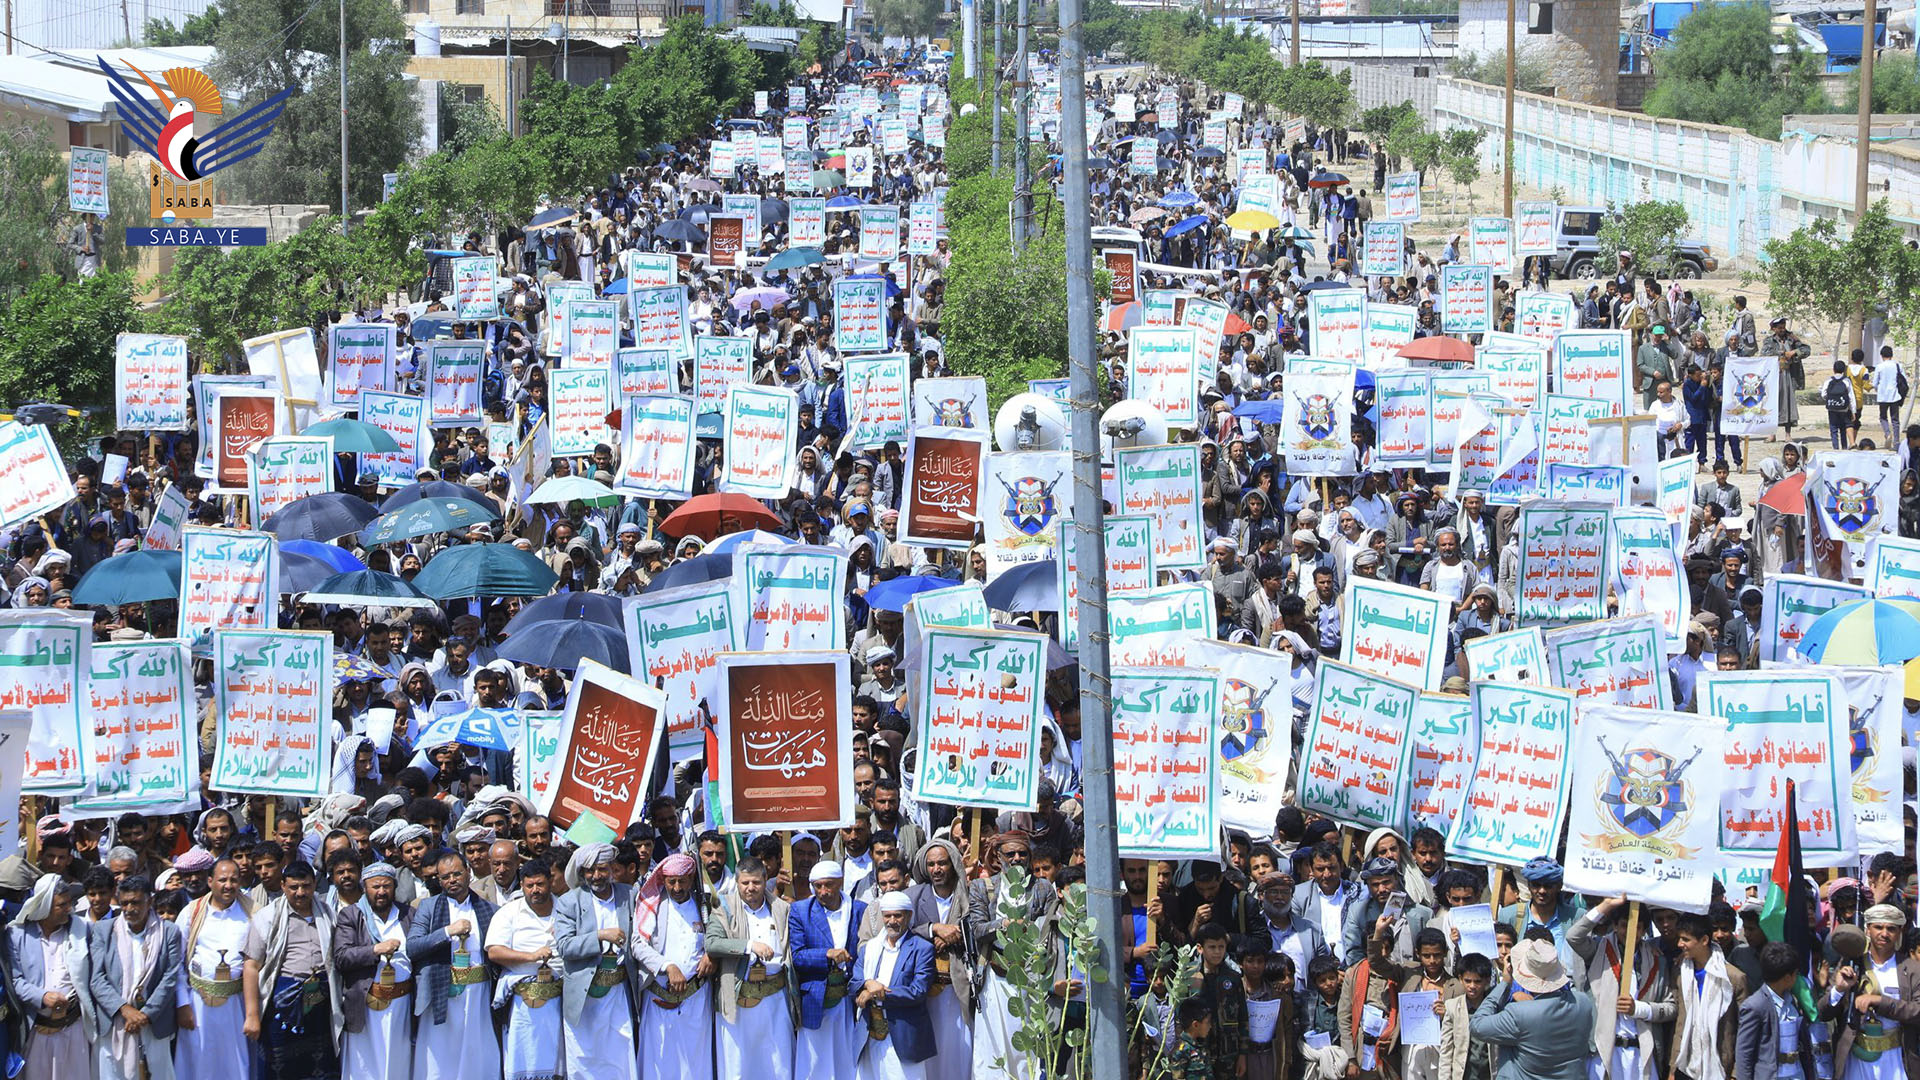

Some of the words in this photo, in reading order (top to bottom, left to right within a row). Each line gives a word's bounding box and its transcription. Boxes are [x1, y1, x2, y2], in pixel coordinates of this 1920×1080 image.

[126, 340, 162, 359] أكبر
[1137, 340, 1191, 356] قاطعوا
[1563, 342, 1620, 360] قاطعوا
[157, 364, 181, 374] الموت
[1563, 366, 1593, 383] الأمريكية
[1593, 368, 1620, 382] البضائع
[157, 379, 181, 391] الموت
[557, 373, 585, 392] أكبر
[634, 403, 688, 424] قاطعوا
[735, 400, 786, 419] قاطعوا
[1549, 401, 1584, 419] أكبر
[1584, 402, 1609, 418] الله
[760, 425, 785, 441] البضائع
[260, 446, 297, 470] أكبر
[298, 449, 324, 465] الله
[1125, 461, 1192, 485] قاطعوا
[1555, 467, 1593, 492] أكبر
[1595, 471, 1620, 490] الله
[1125, 491, 1161, 511] الأمريكية
[1162, 490, 1192, 509] البضائع
[1529, 515, 1576, 541] أكبر
[1575, 519, 1603, 537] الله
[1617, 529, 1671, 554] قاطعوا
[1527, 544, 1566, 560] لأمريكا
[1569, 545, 1600, 559] الموت
[751, 565, 829, 596] قاطعوا
[1525, 565, 1565, 581] لإسرائيل
[1567, 566, 1600, 579] الموت
[1523, 586, 1552, 601] اليهود
[1554, 589, 1570, 601] على
[1573, 586, 1597, 598] اللعنة
[753, 602, 791, 625] الأمريكية
[792, 606, 829, 626] البضائع
[1358, 599, 1431, 636] قاطعوا
[1521, 604, 1560, 620] للإسلام
[1566, 604, 1598, 621] النصر
[644, 605, 727, 649] قاطعوا
[782, 631, 790, 649] و
[1354, 637, 1392, 662] الأمريكية
[225, 642, 283, 672] أكبر
[284, 648, 319, 670] الله
[935, 641, 996, 677] أكبر
[997, 648, 1035, 675] الله
[1392, 647, 1425, 667] البضائع
[1477, 643, 1509, 676] أكبر
[1510, 642, 1535, 666] الله
[1567, 640, 1617, 679] أكبر
[1620, 639, 1653, 664] الله
[138, 653, 176, 677] الله
[227, 676, 274, 696] لأمريكا
[277, 682, 318, 699] الموت
[690, 680, 697, 701] و
[934, 678, 984, 701] لأمريكا
[1618, 671, 1653, 691] الموت
[133, 685, 177, 708] الموت
[988, 682, 1031, 704] الموت
[1111, 683, 1168, 720] أكبر
[1169, 686, 1210, 715] الله
[1325, 682, 1376, 710] أكبر
[228, 704, 274, 723] لإسرائيل
[276, 707, 317, 726] الموت
[1374, 694, 1408, 719] الله
[1485, 696, 1532, 726] أكبر
[1718, 694, 1825, 732] قاطعوا
[134, 715, 179, 735] الموت
[932, 707, 983, 729] لإسرائيل
[986, 715, 1029, 734] الموت
[1320, 708, 1362, 735] لأمريكا
[1418, 707, 1475, 742] أكبر
[1531, 705, 1565, 732] الله
[227, 731, 259, 749] اليهود
[262, 733, 281, 752] على
[286, 735, 316, 750] اللعنة
[1162, 728, 1207, 747] الموت
[1364, 726, 1402, 745] الموت
[1483, 734, 1519, 756] لأمريكا
[121, 744, 141, 765] على
[146, 742, 180, 758] اللعنة
[930, 737, 965, 756] اليهود
[969, 740, 990, 760] على
[994, 739, 1027, 759] اللعنة
[1315, 735, 1357, 760] لإسرائيل
[1416, 743, 1463, 764] لأمريكا
[1522, 744, 1562, 760] الموت
[1777, 741, 1826, 769] البضائع
[223, 753, 270, 785] للإسلام
[271, 755, 316, 783] النصر
[1162, 756, 1207, 777] الموت
[1310, 761, 1341, 780] اليهود
[1360, 751, 1398, 771] الموت
[136, 764, 182, 797] النصر
[927, 762, 978, 793] للإسلام
[981, 765, 1026, 795] النصر
[1342, 772, 1361, 790] على
[1413, 771, 1462, 793] لإسرائيل
[1475, 762, 1516, 784] لإسرائيل
[1518, 773, 1558, 790] الموت
[1144, 787, 1166, 807] على
[1171, 785, 1206, 803] اللعنة
[1365, 779, 1393, 796] اللعنة
[1770, 776, 1778, 798] و
[1304, 784, 1350, 812] للإسلام
[1468, 791, 1499, 809] اليهود
[1501, 800, 1519, 815] على
[1353, 801, 1390, 823] النصر
[1524, 799, 1554, 819] اللعنة
[1158, 811, 1206, 843] النصر
[1461, 811, 1506, 846] للإسلام
[1507, 825, 1548, 850] النصر
